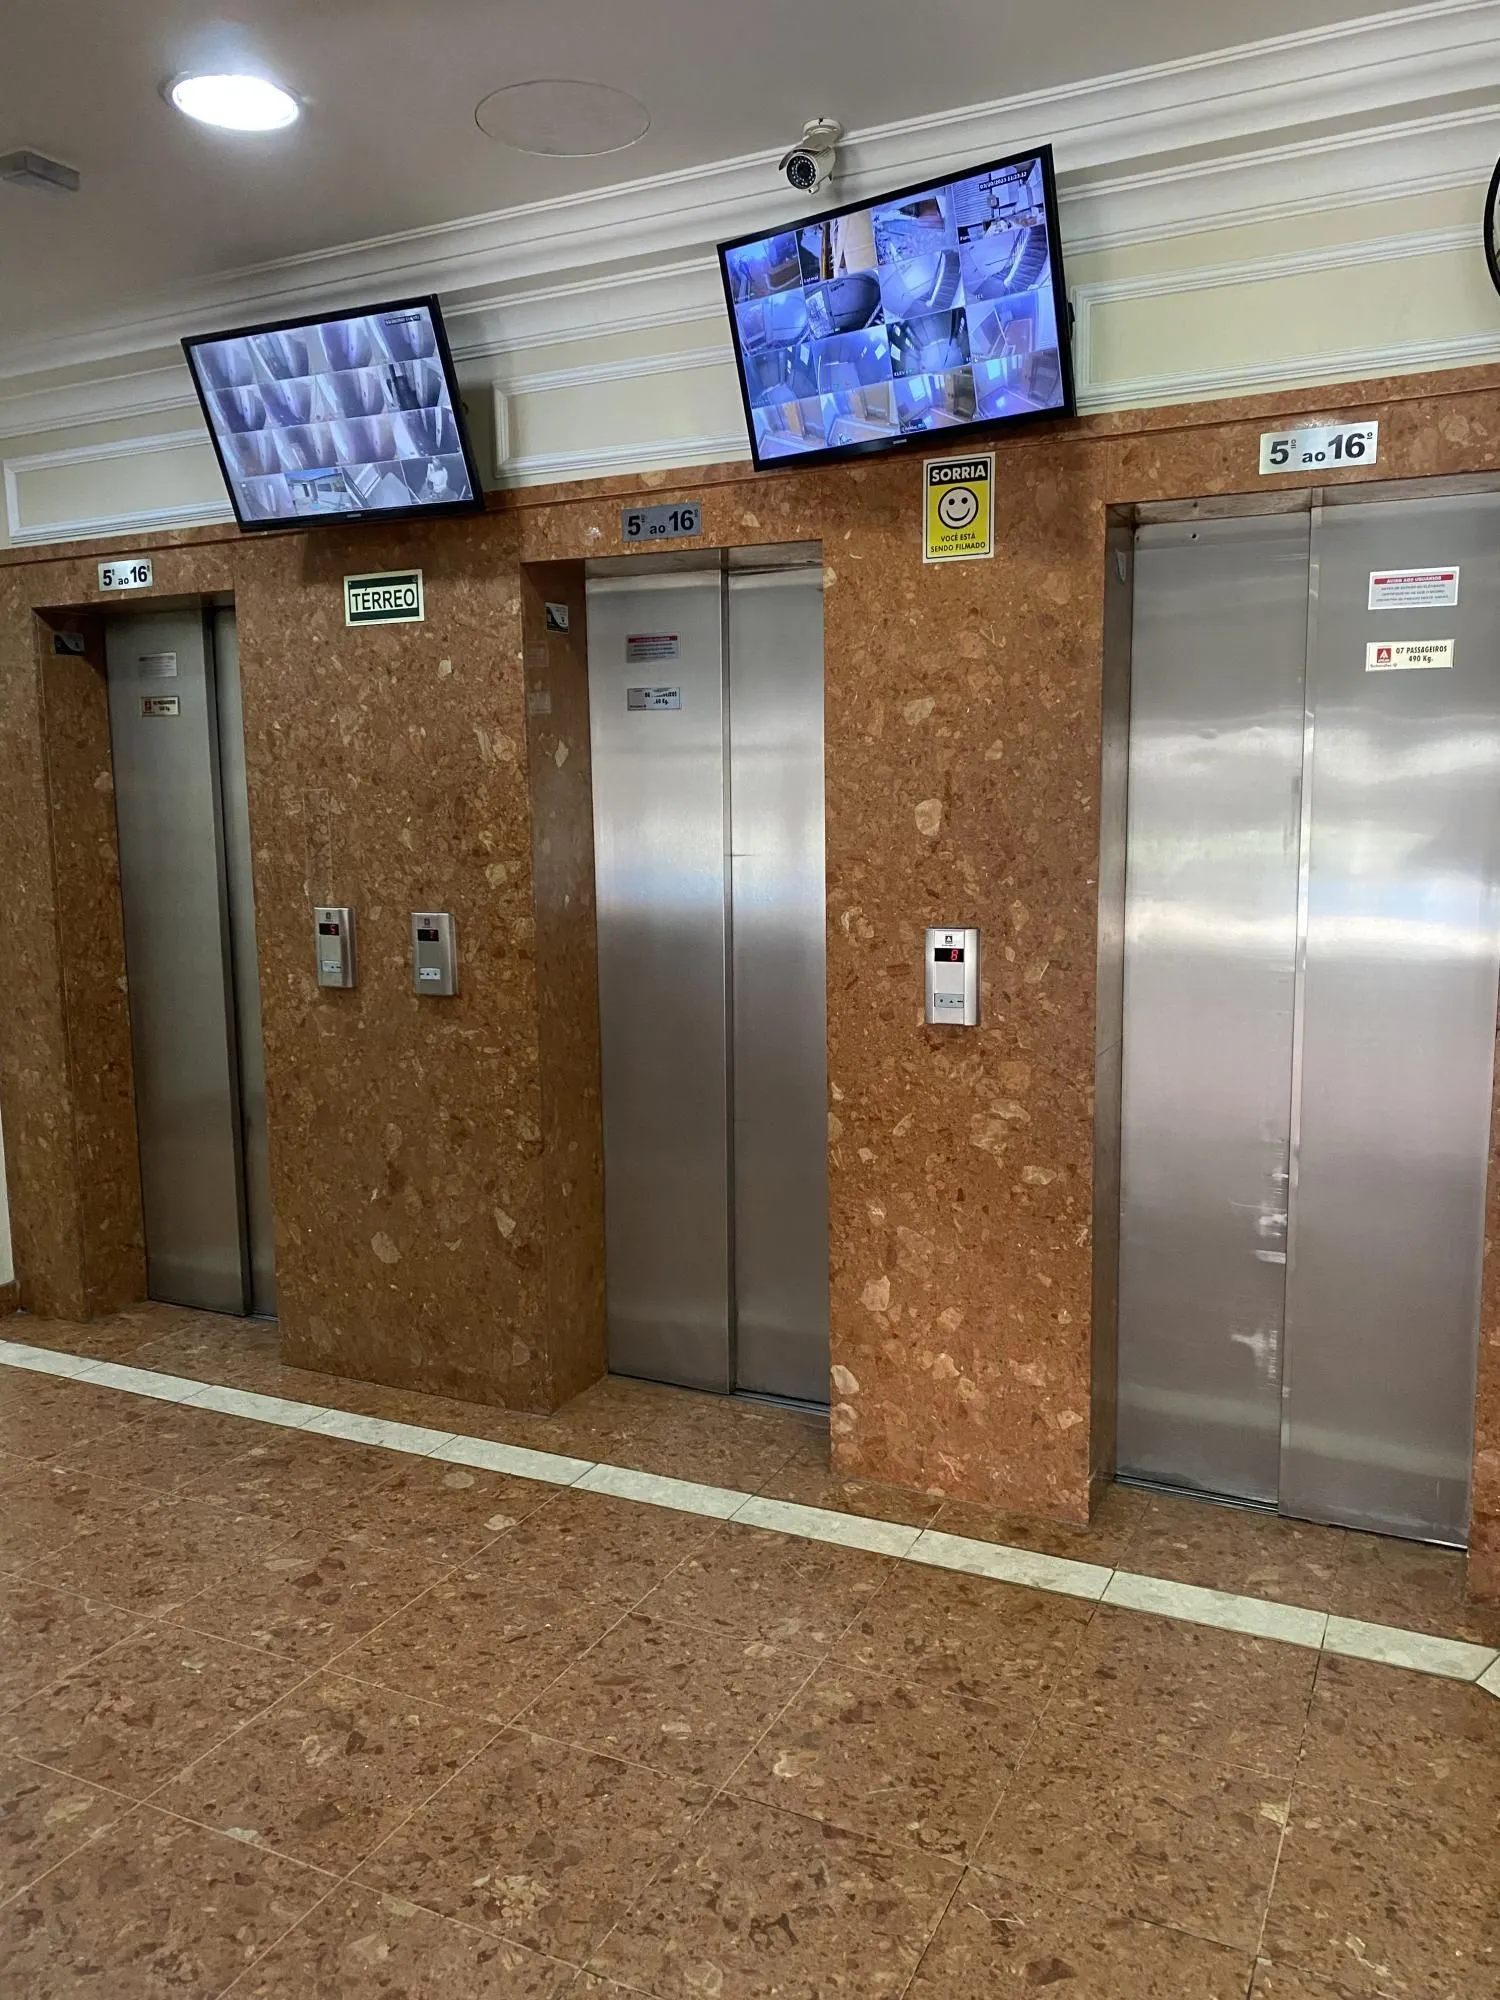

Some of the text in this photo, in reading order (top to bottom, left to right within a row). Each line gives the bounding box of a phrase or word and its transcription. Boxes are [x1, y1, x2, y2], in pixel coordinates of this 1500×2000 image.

[1269, 431, 1373, 465] 5º ao 16º
[931, 464, 986, 482] SORRIA
[649, 524, 666, 535] ao
[941, 532, 959, 542] VOCÊ
[930, 541, 986, 553] SENDO FILMADO
[117, 577, 130, 586] ao
[352, 587, 415, 611] TÉRREO
[1395, 645, 1447, 655] 07 PASSAGEIROS
